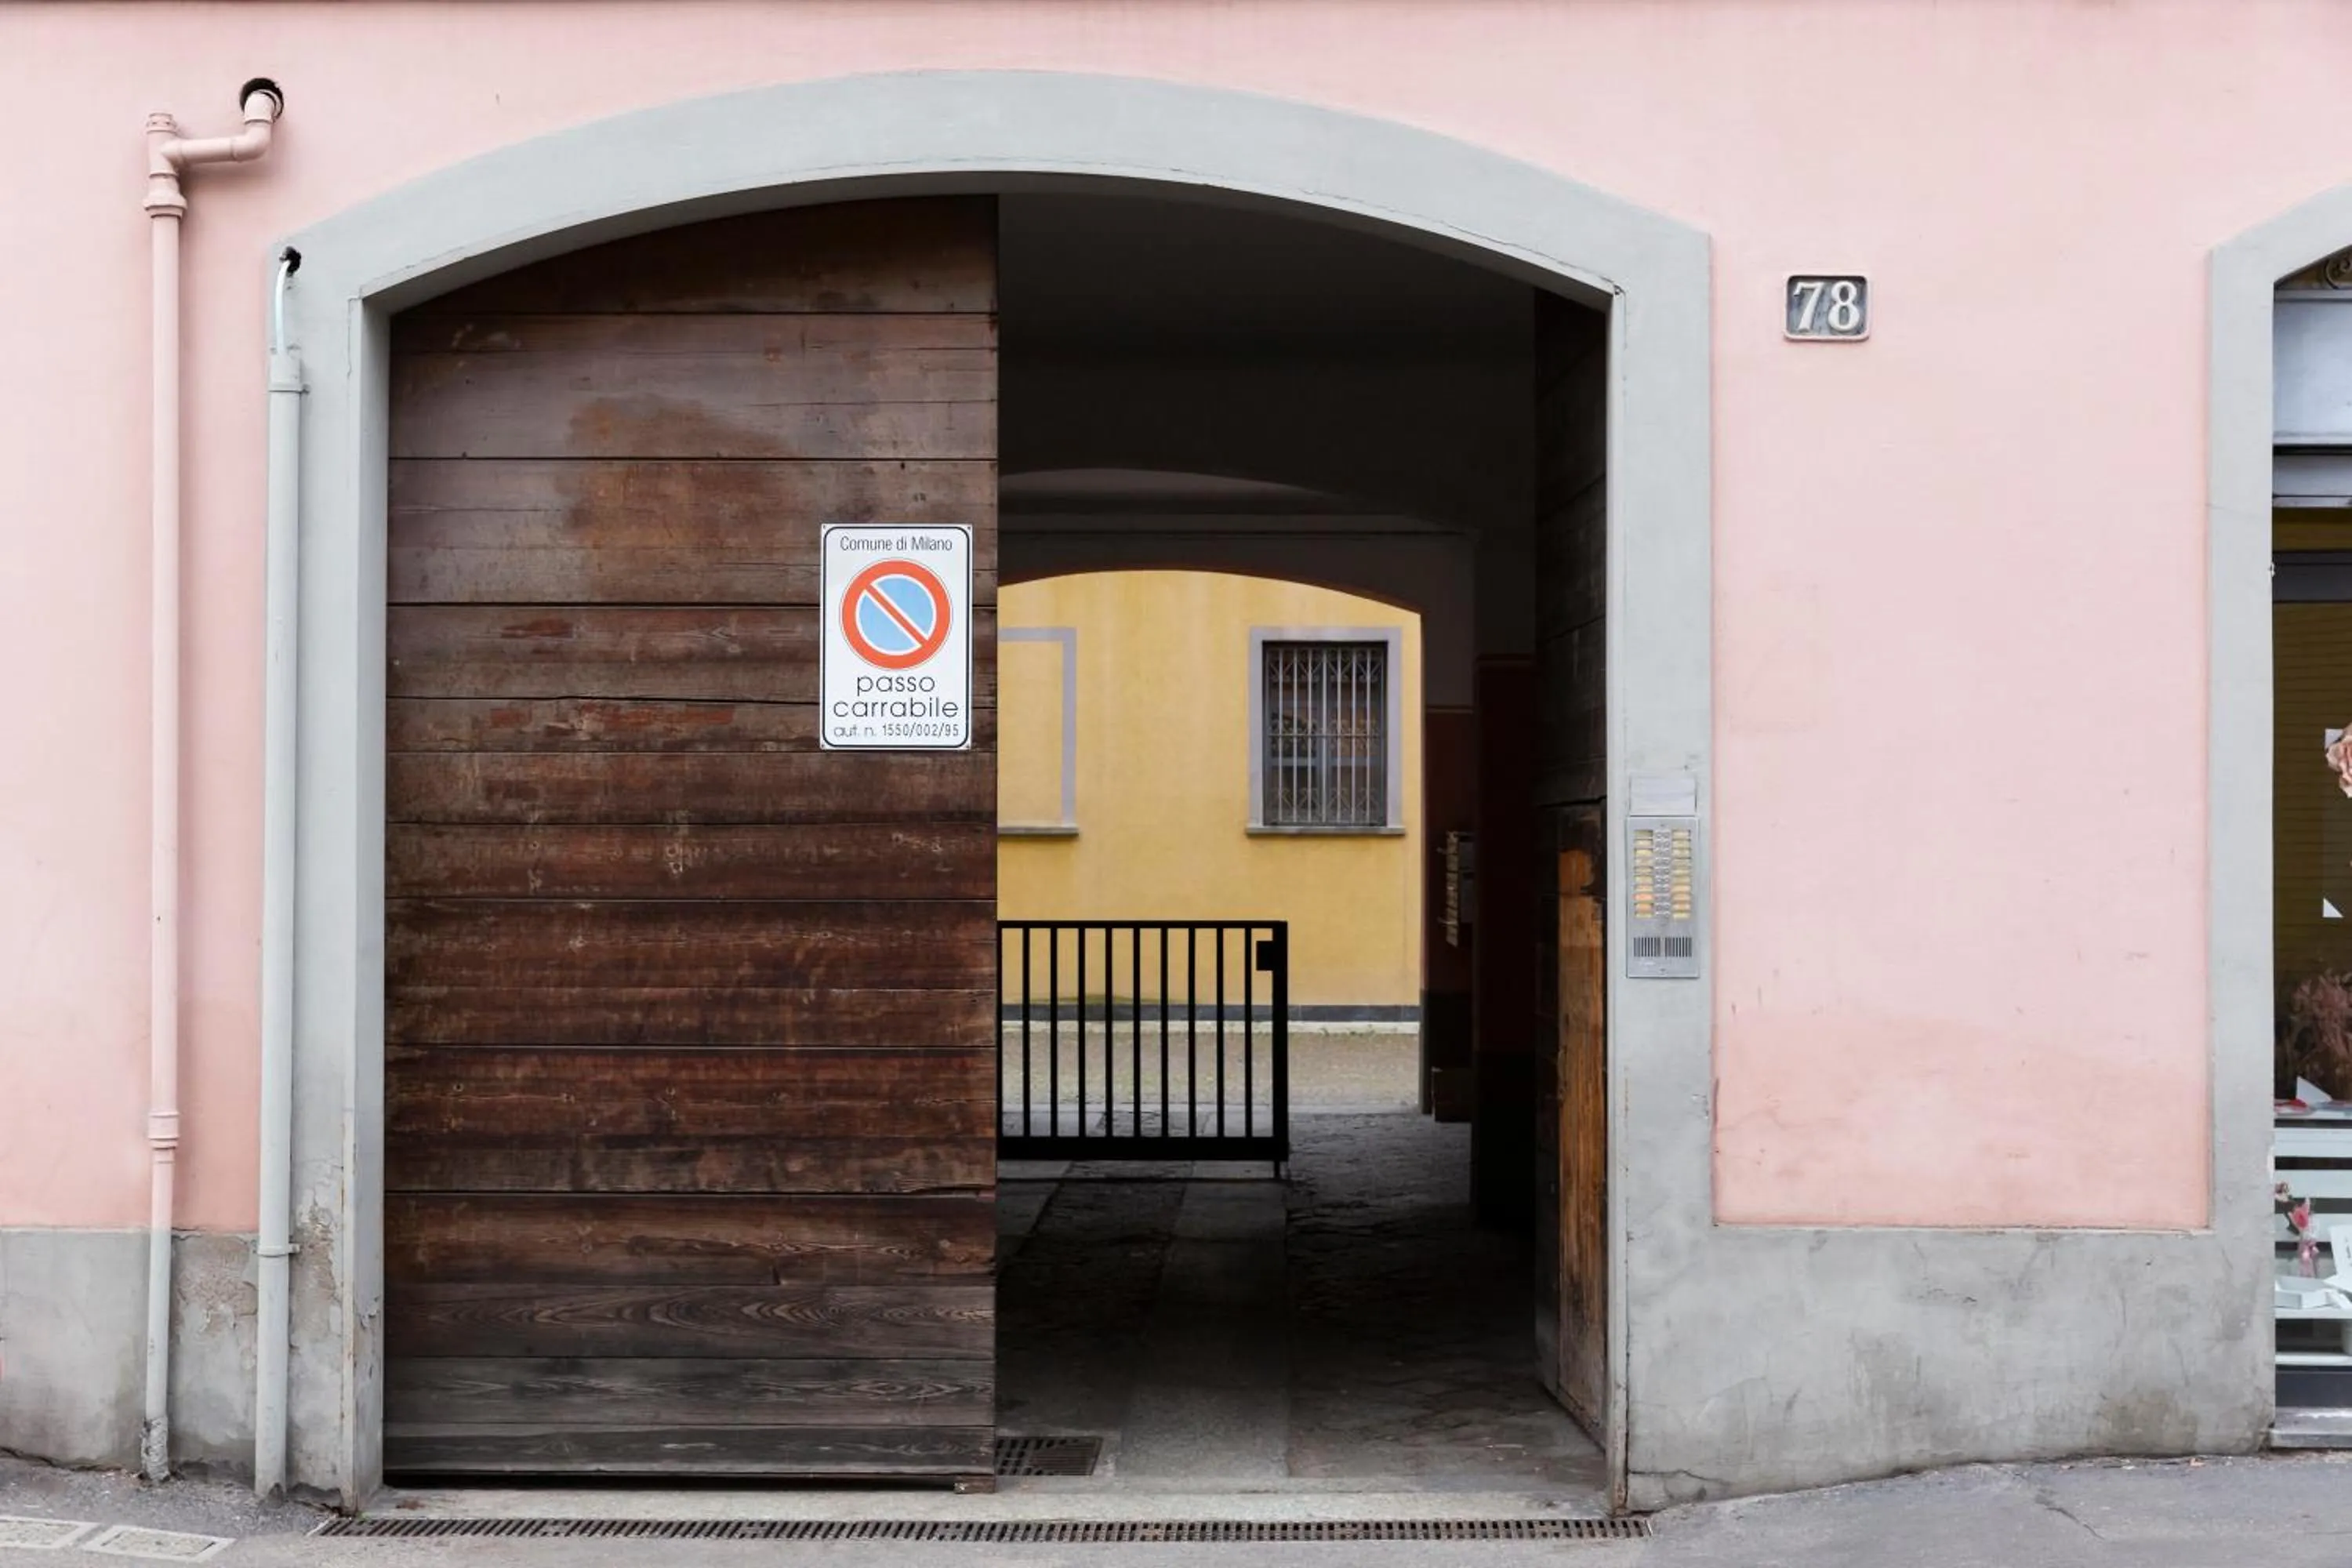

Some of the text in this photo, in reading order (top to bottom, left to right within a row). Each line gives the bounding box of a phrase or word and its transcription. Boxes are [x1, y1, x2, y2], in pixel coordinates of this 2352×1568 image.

[1793, 281, 1860, 330] 78
[840, 535, 953, 551] Comune di Milano
[856, 675, 935, 696] passo
[833, 697, 959, 718] carrabile
[833, 721, 960, 738] aut. n. 1550/002/95
